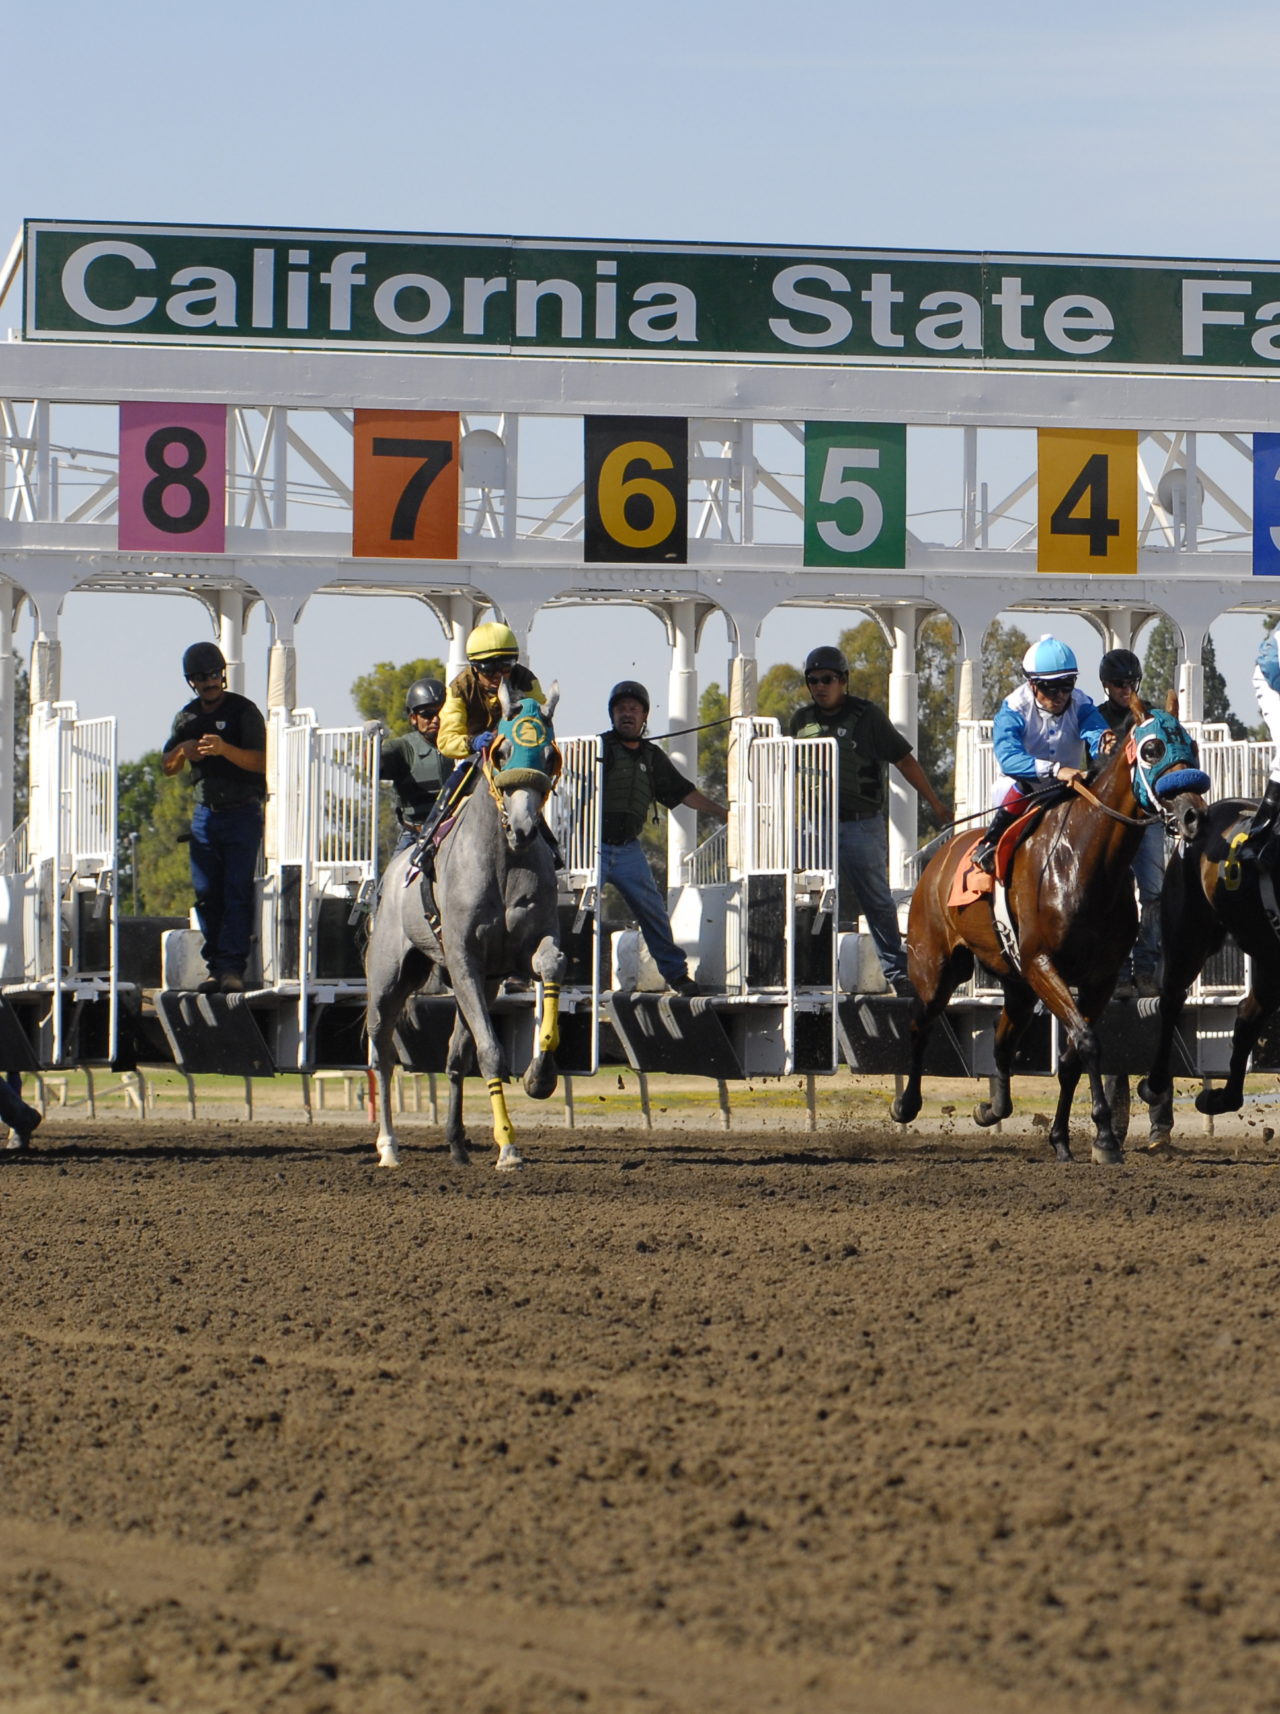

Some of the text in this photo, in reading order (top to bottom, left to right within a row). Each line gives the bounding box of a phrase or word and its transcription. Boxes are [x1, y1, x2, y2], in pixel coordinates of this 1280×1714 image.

[61, 240, 698, 342] California
[768, 264, 1115, 354] State
[142, 426, 209, 534] 8
[371, 437, 453, 541] 7
[597, 441, 677, 548] 6
[816, 447, 883, 552] 5
[1050, 454, 1120, 557] 4
